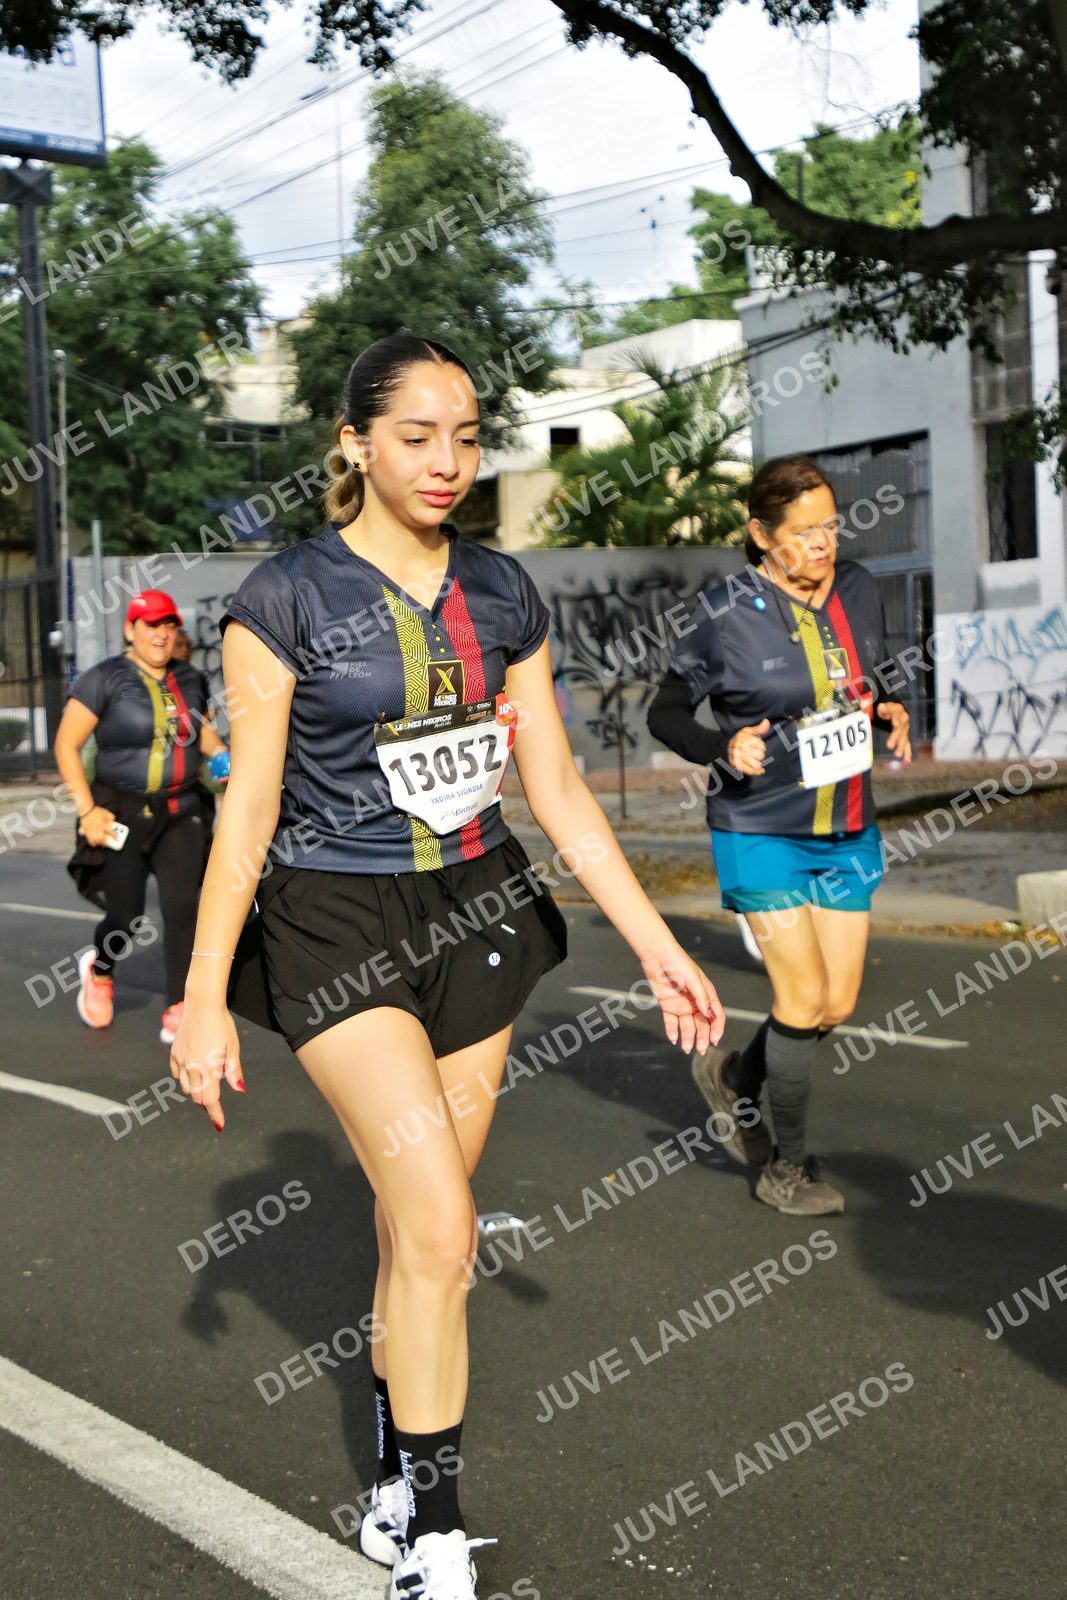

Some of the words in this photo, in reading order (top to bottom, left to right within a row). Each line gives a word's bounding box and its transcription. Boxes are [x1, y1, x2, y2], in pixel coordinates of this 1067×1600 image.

[806, 720, 868, 760] 12105
[388, 734, 502, 796] 13052
[430, 790, 456, 805] YADIRA
